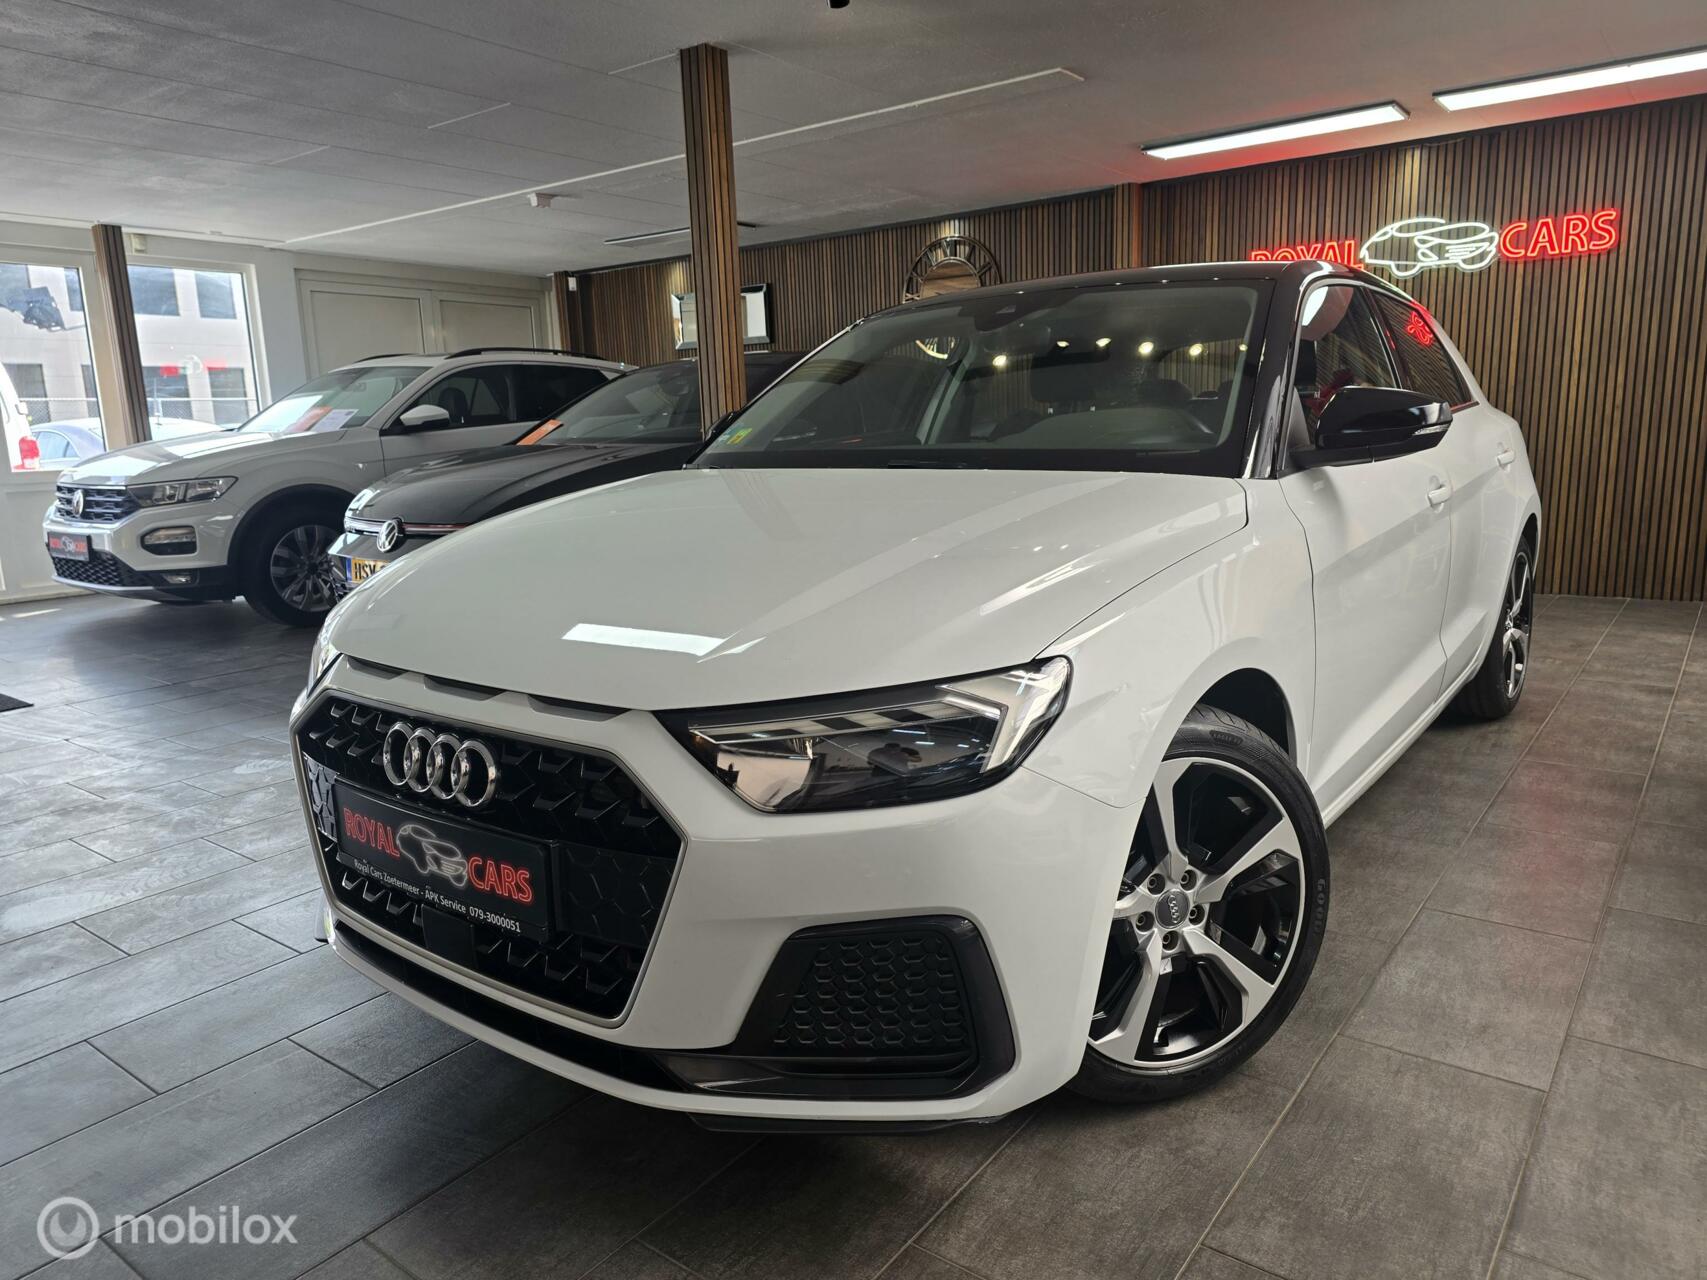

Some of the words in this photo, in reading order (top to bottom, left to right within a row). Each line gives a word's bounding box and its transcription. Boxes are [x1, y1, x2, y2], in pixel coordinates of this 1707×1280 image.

[1500, 210, 1617, 257] CARS
[343, 807, 401, 858] ROYAL
[468, 856, 533, 903] CARS
[354, 859, 370, 874] Royal
[370, 866, 383, 880] Cars
[383, 872, 420, 896] Zoetermeer
[425, 889, 439, 904] APK
[440, 895, 467, 914] Service
[469, 906, 521, 933] 079-3000051
